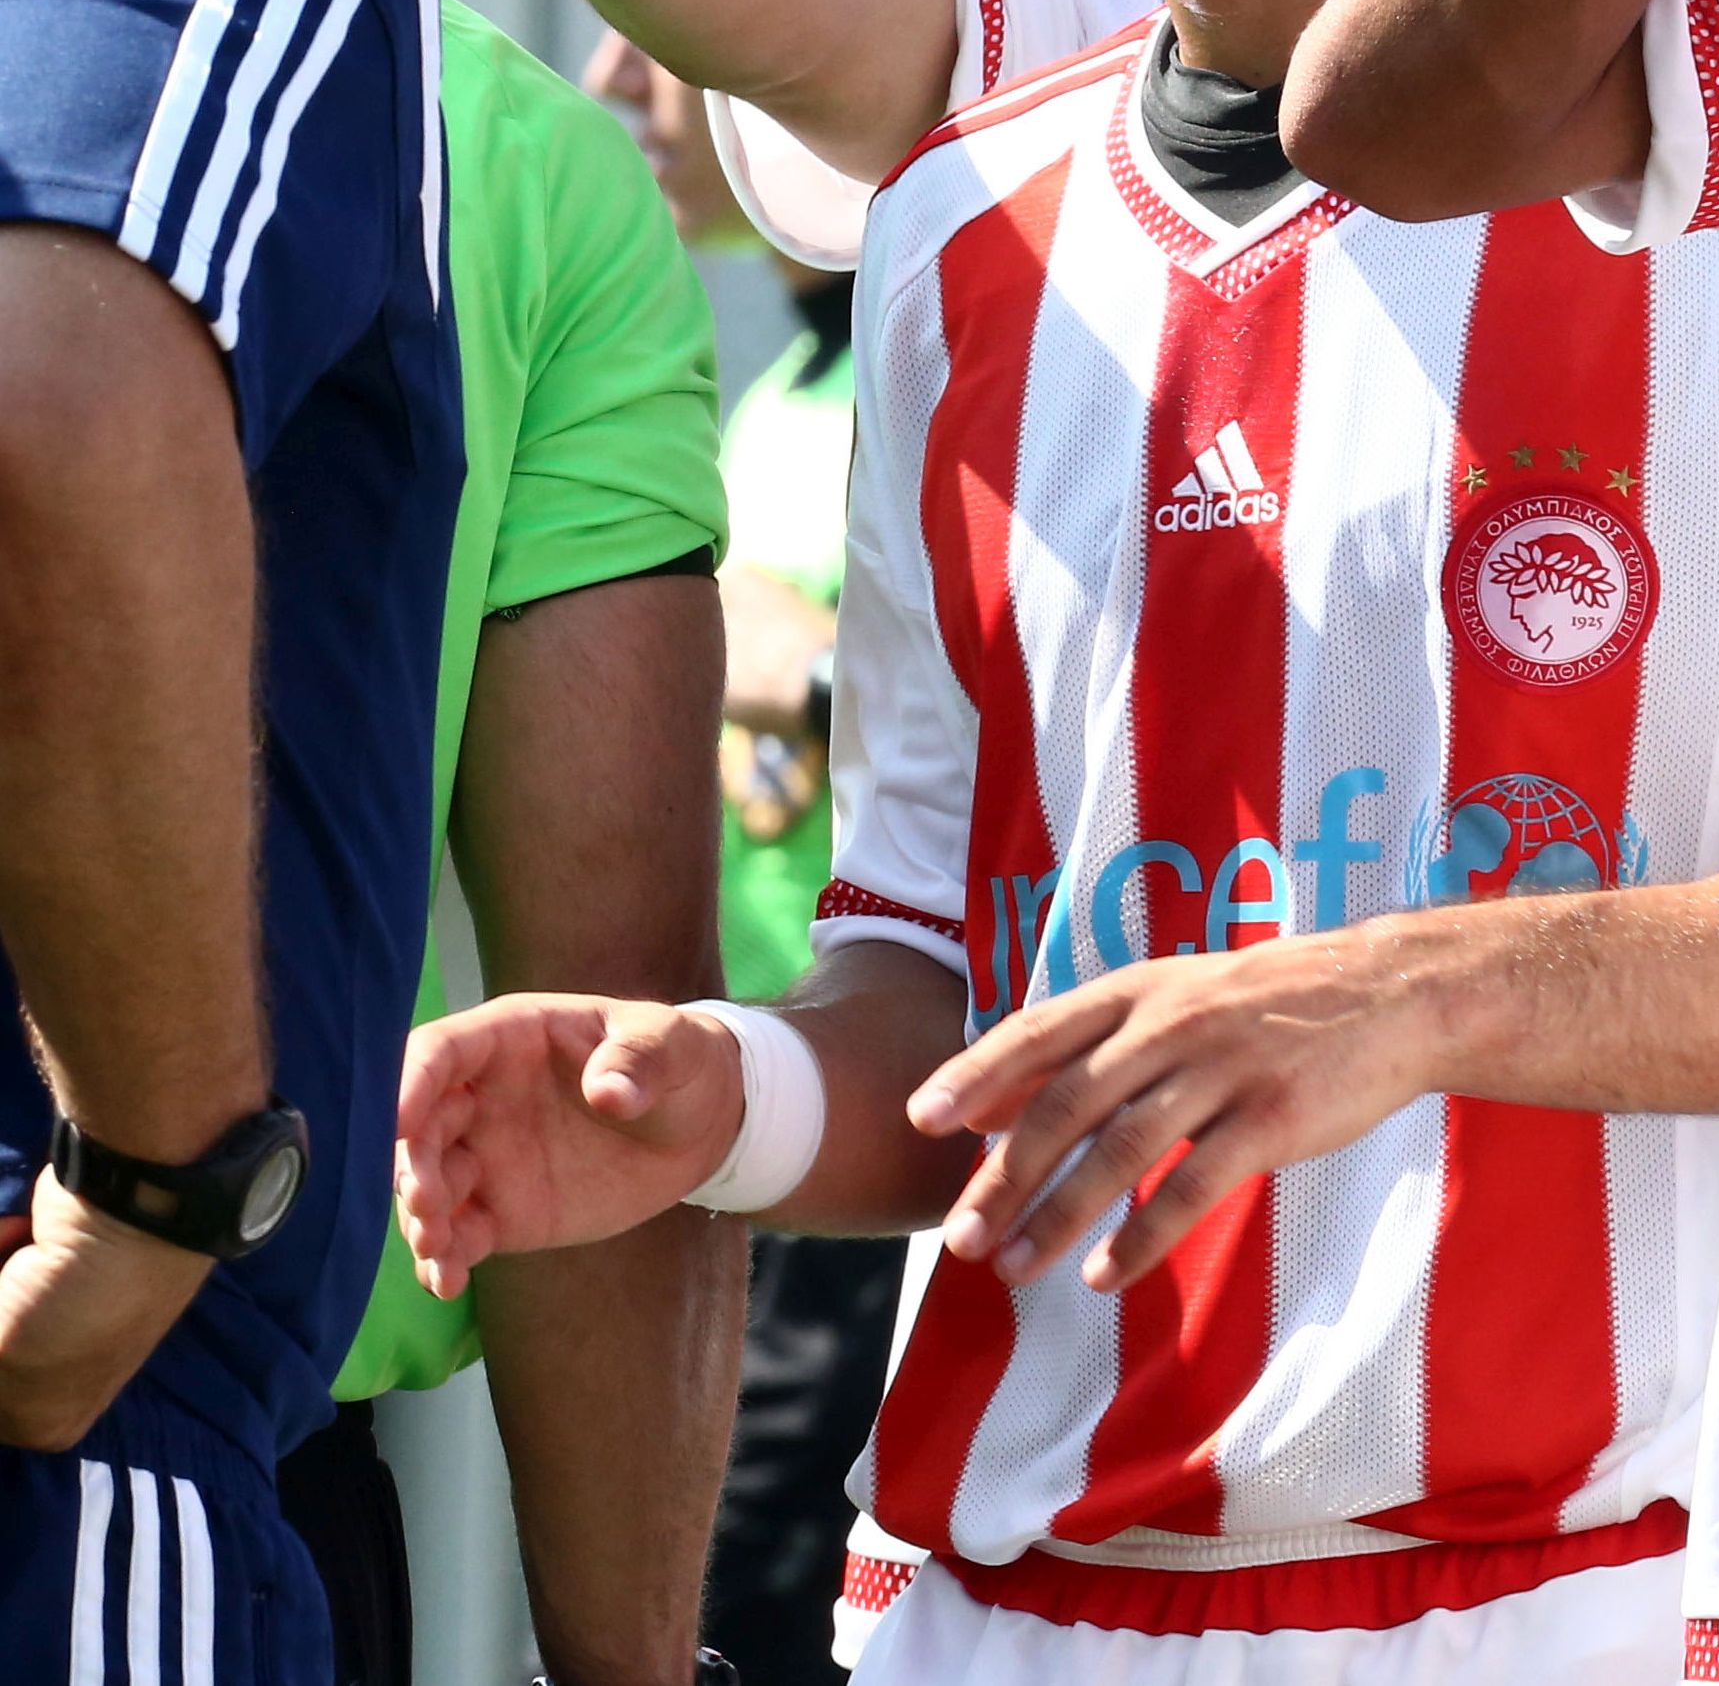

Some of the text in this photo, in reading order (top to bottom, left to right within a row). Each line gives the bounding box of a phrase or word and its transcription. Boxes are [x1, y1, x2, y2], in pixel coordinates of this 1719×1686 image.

[1154, 488, 1281, 533] adidas
[1486, 500, 1623, 542] ΟΛΥΜΠΙΑΚΟΣ
[1571, 616, 1604, 630] 1925
